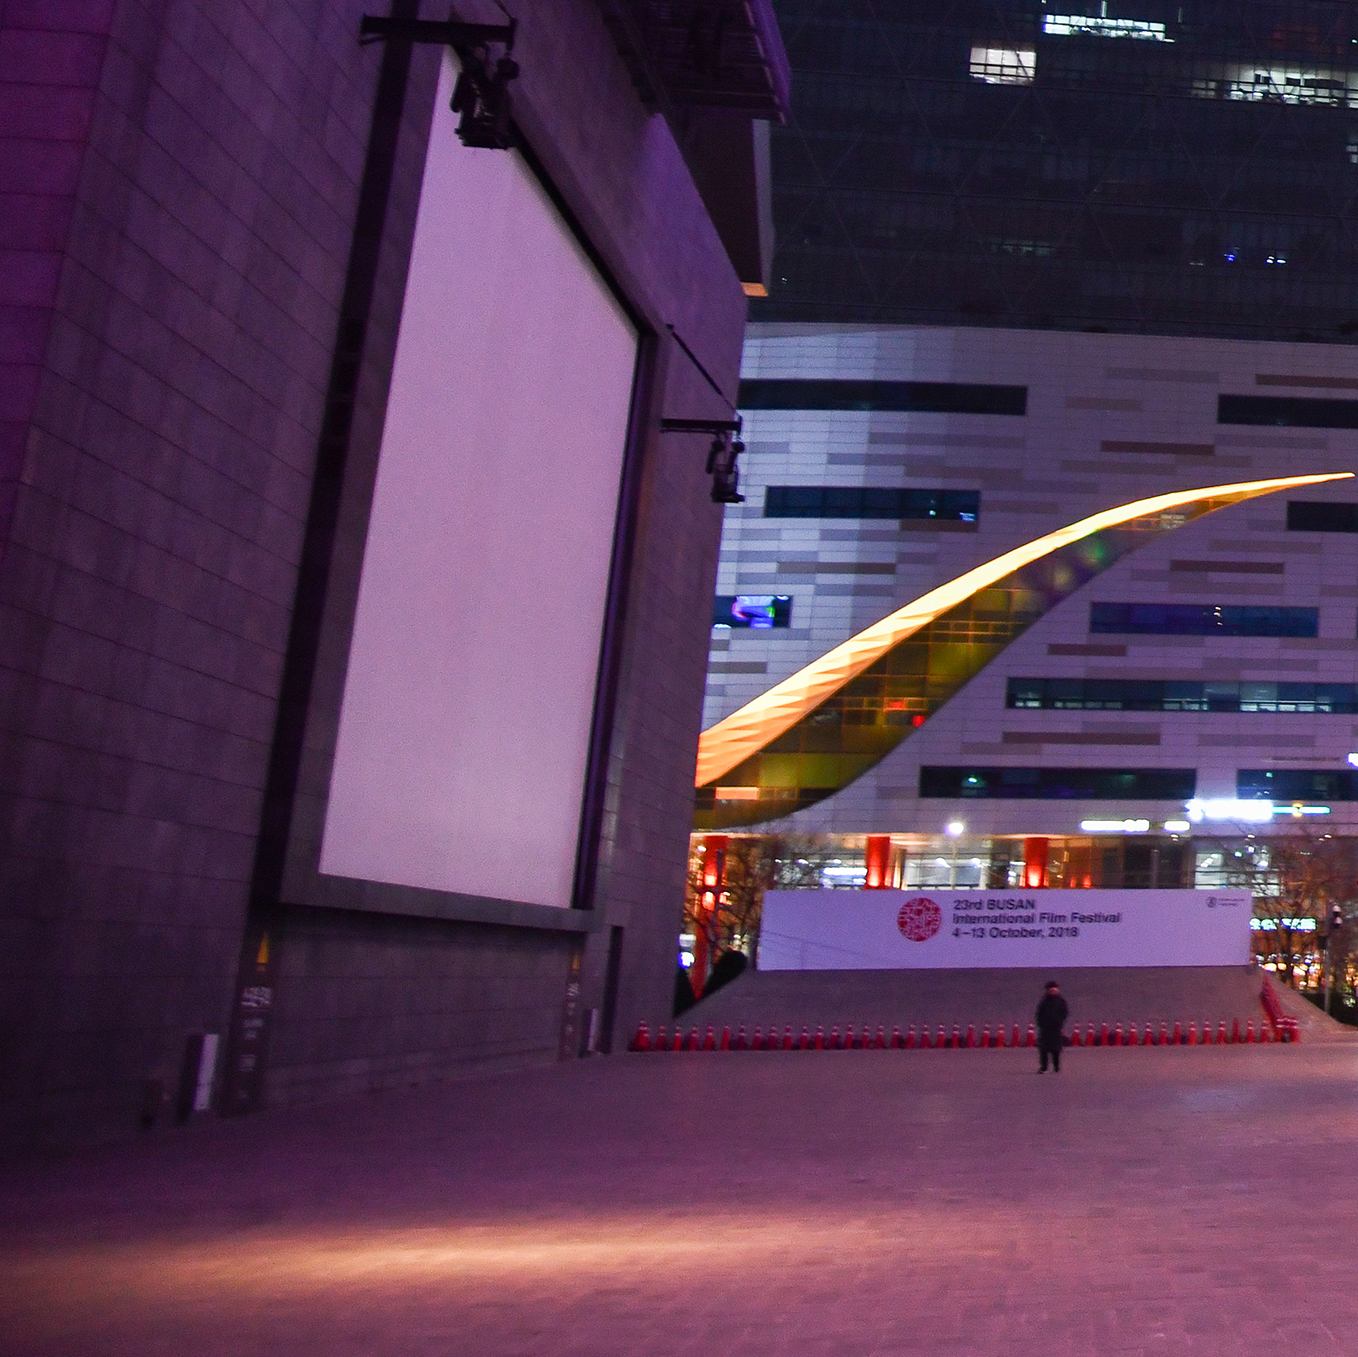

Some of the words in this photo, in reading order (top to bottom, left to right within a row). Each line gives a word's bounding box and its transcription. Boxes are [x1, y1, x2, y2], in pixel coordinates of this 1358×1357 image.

[953, 899, 982, 910] 23rd
[987, 899, 1035, 910] BUSAN
[952, 912, 1034, 923] International
[1039, 912, 1067, 923] Film
[1071, 912, 1121, 923] Festival
[989, 927, 1044, 939] October,
[1049, 926, 1078, 938] 2018
